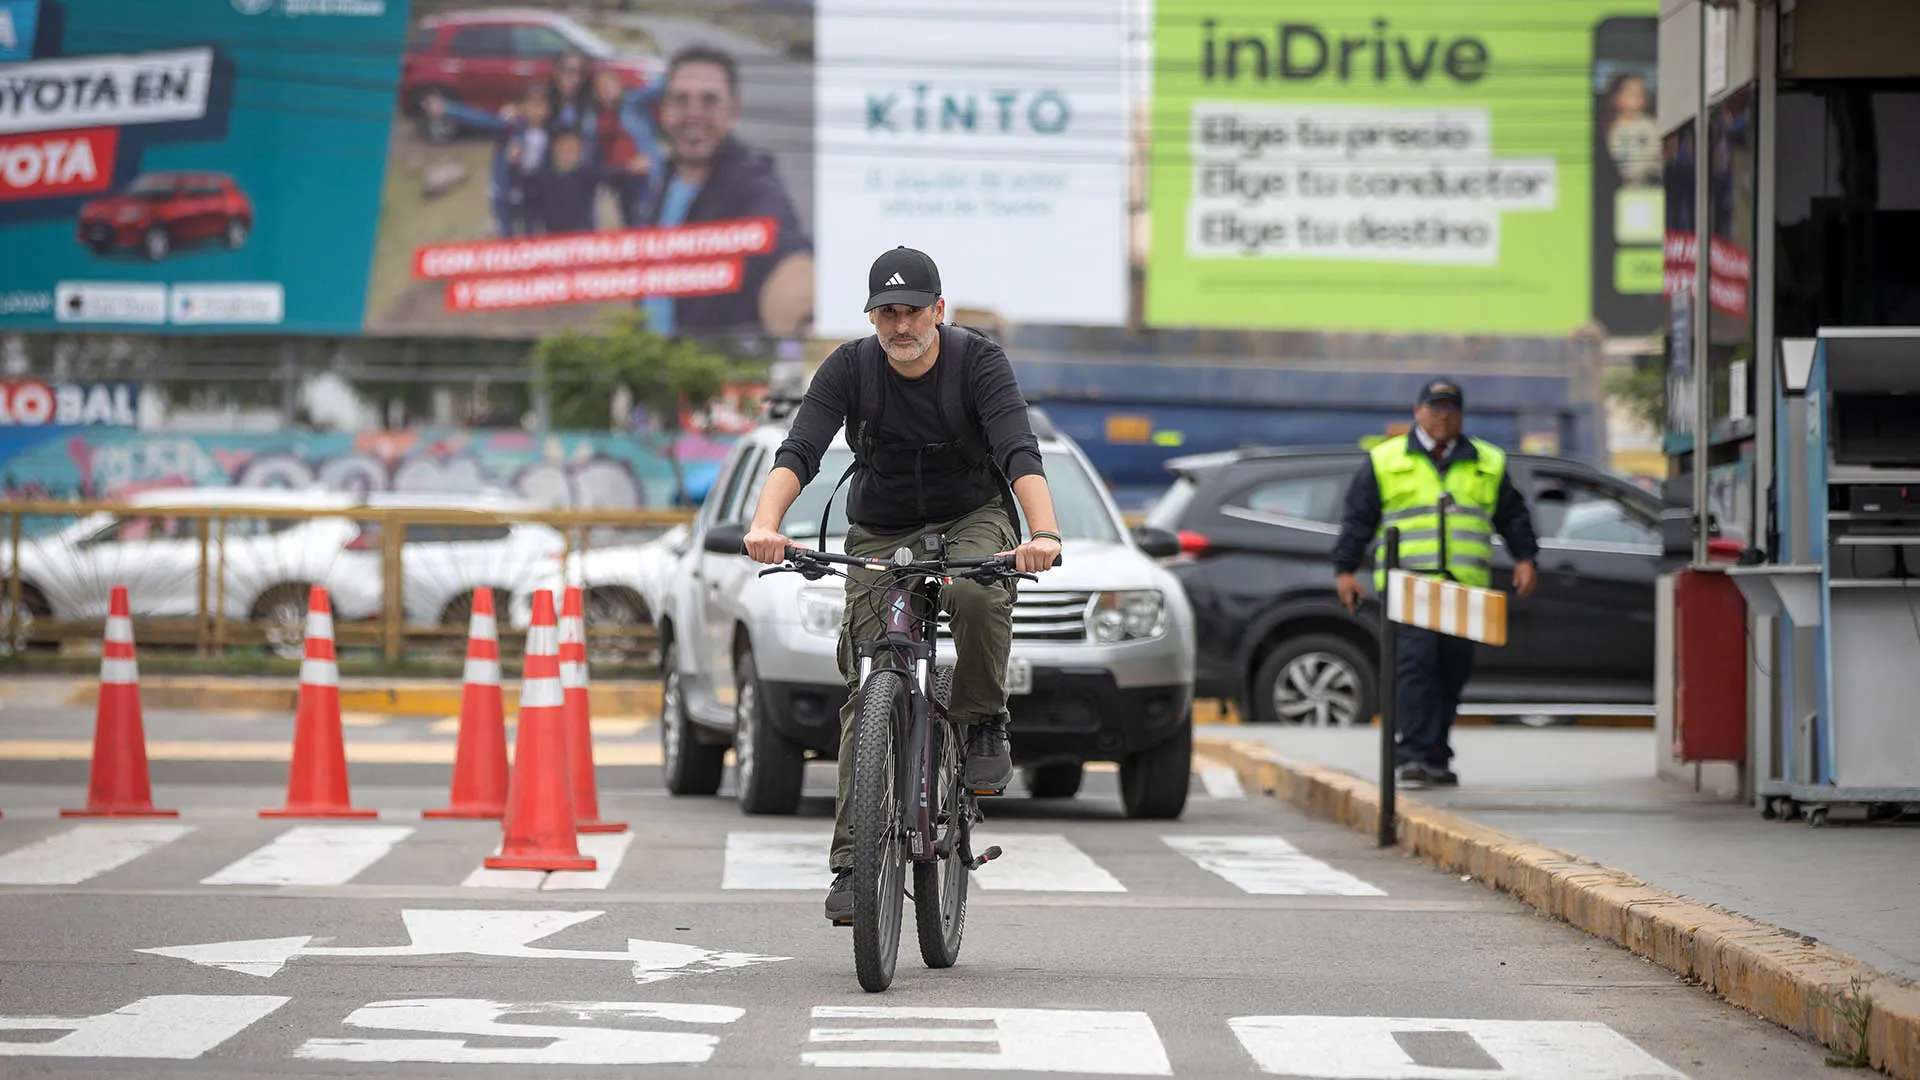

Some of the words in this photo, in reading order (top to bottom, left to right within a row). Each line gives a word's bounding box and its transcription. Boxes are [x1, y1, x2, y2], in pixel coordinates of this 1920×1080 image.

[1202, 19, 1488, 82] inDrive
[133, 68, 190, 104] EN
[1201, 117, 1287, 158] Elige
[1298, 118, 1338, 147] tu
[1347, 117, 1472, 158] precio
[1201, 165, 1287, 205] Elige
[1298, 169, 1338, 197] tu
[1347, 163, 1547, 198] conductor
[1201, 214, 1287, 253] Elige
[1298, 218, 1338, 245] tu
[1347, 213, 1489, 247] destino
